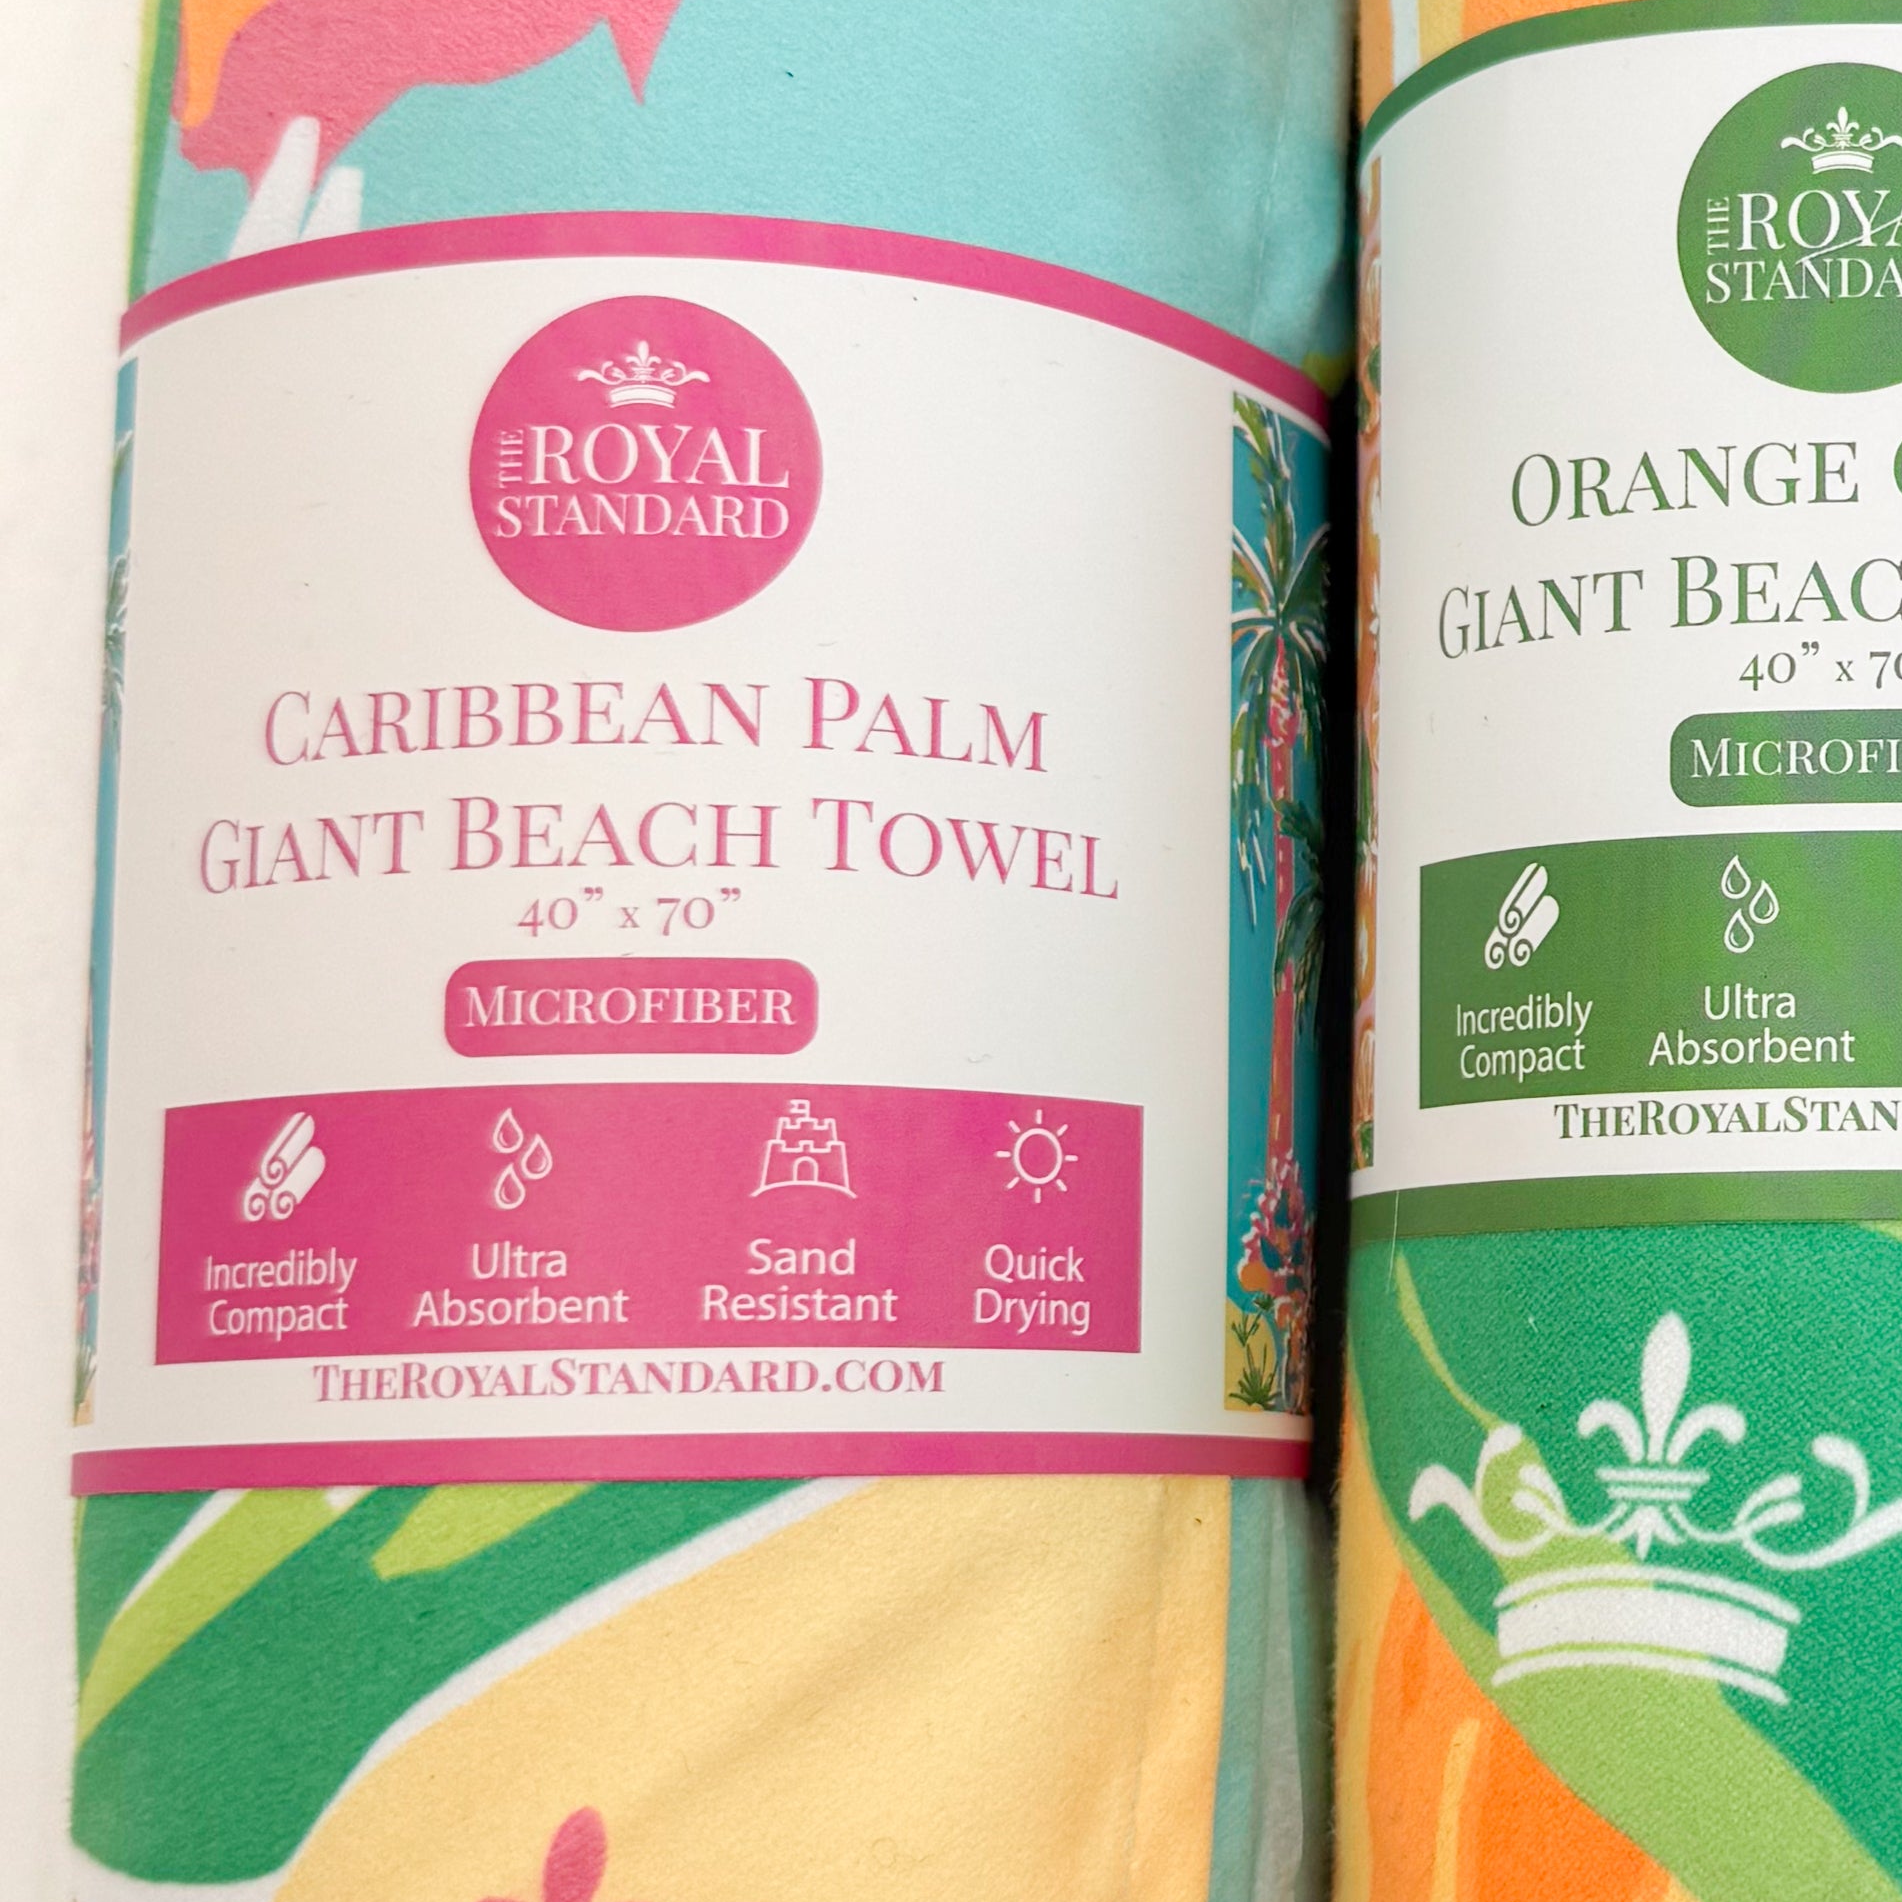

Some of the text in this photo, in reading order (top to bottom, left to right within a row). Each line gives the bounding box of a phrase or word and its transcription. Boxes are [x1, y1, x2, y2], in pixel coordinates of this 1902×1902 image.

[1705, 197, 1730, 253] THE
[498, 422, 790, 490] THE ROYAL
[1510, 441, 1859, 528] ORANGE
[493, 494, 791, 542] STANDARD
[1437, 570, 1643, 658] GIANT
[264, 676, 1049, 774] CARIBBEAN PALM
[199, 797, 1121, 901] GIANT BEACH TOWEL
[463, 983, 798, 1029] MICROFIBER
[1455, 995, 1594, 1039] Incredibly
[1703, 984, 1798, 1020] Ultra
[1458, 1039, 1586, 1082] Compact
[1648, 1026, 1856, 1066] Absorbent
[204, 1247, 358, 1295] Incredibly
[470, 1242, 569, 1279] Ultra
[747, 1237, 857, 1277] Sand
[983, 1245, 1086, 1287] Quick
[208, 1297, 349, 1343] Compact
[413, 1287, 630, 1327] Absorbent
[702, 1283, 899, 1324] Resistant
[973, 1290, 1092, 1338] Drying
